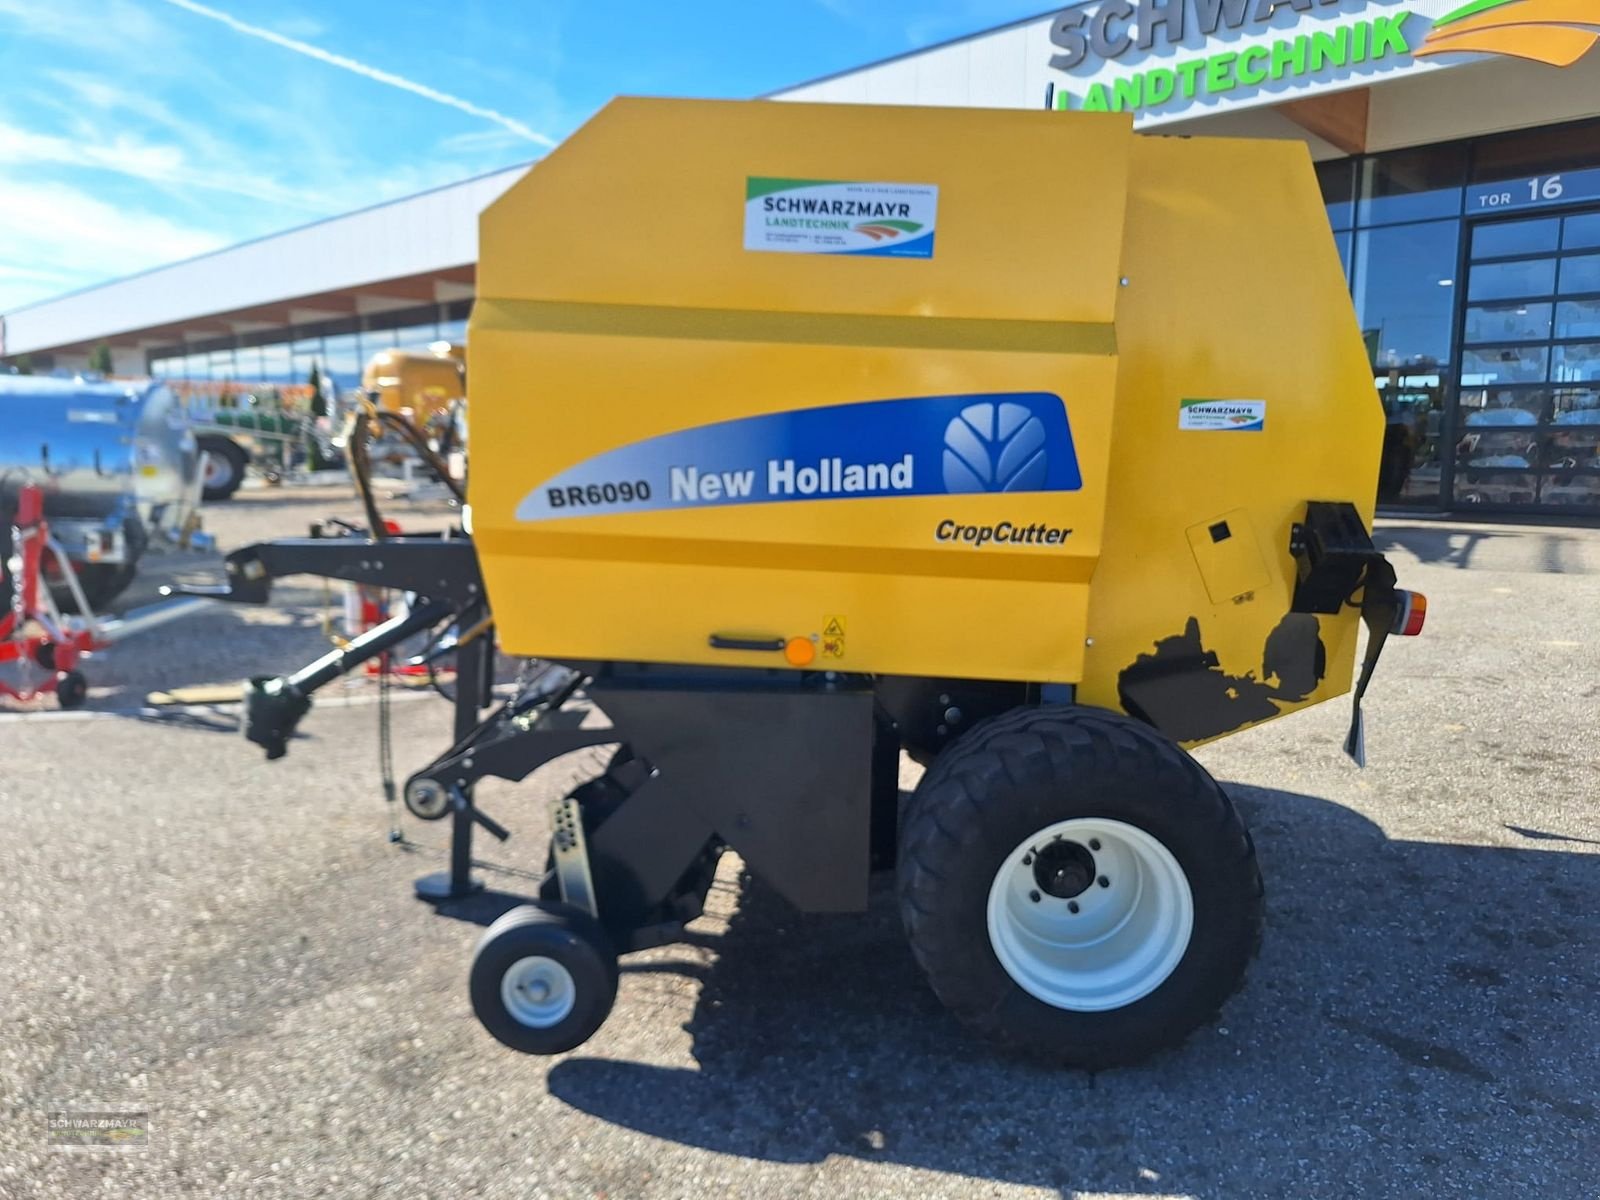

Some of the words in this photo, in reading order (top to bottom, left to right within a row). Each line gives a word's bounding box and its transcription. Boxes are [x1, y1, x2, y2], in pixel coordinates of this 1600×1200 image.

[1049, 0, 1339, 70] SCHW
[1479, 192, 1511, 207] TOR
[1528, 175, 1563, 201] 16
[764, 196, 910, 218] SCHWARZMAYR
[765, 217, 849, 231] LANDTECHNIK
[1188, 406, 1253, 415] SCHWARZMAYR
[548, 480, 651, 508] BR6090
[670, 466, 755, 502] New
[767, 454, 914, 495] Holland
[935, 519, 1072, 547] CropCutter
